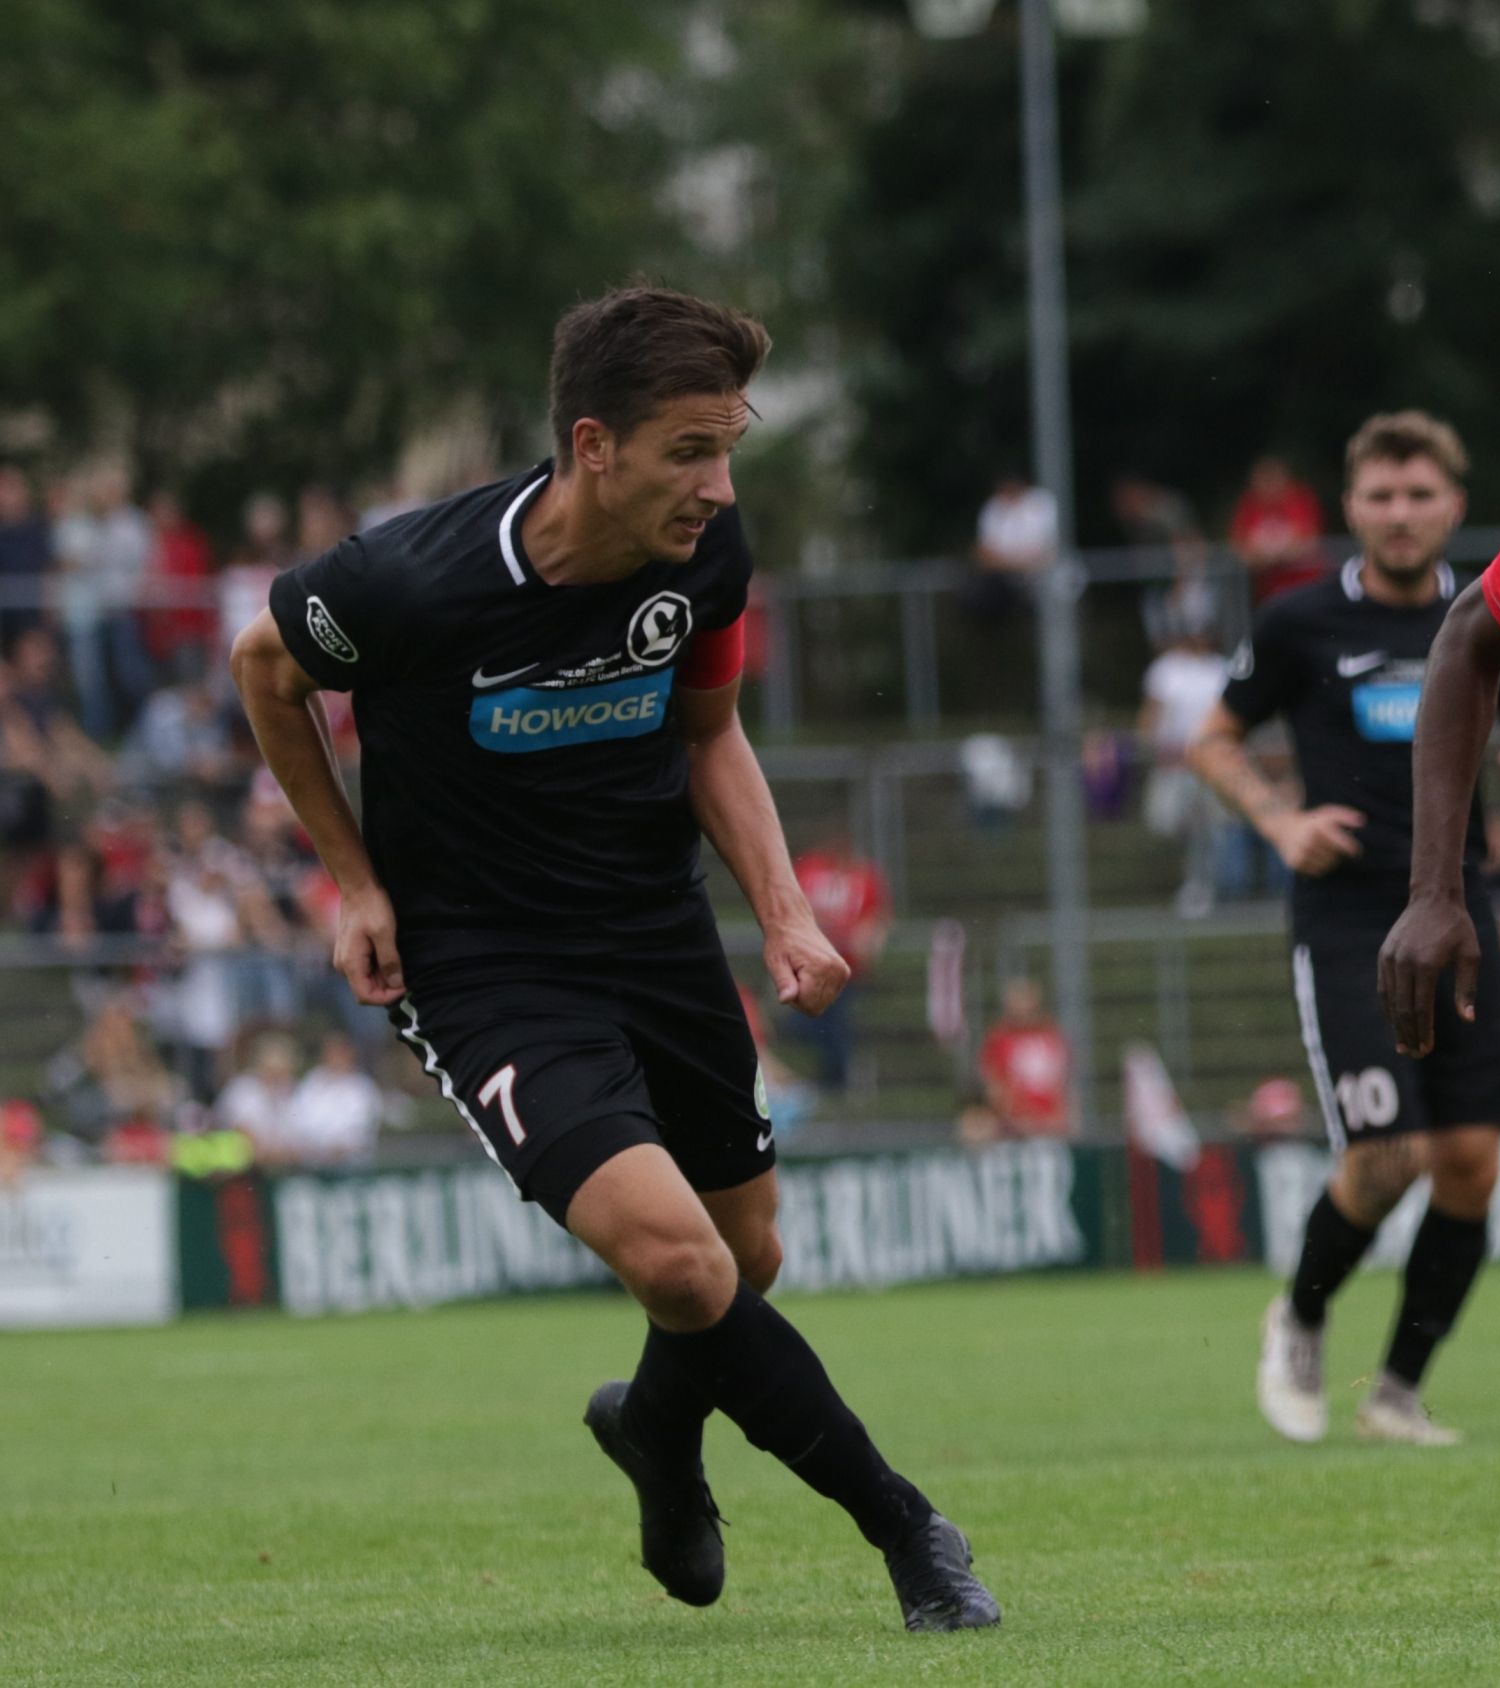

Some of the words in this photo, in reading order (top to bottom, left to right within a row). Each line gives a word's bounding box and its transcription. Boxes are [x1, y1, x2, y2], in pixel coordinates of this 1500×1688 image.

[490, 691, 659, 735] HOWOGE
[477, 1063, 527, 1147] 7
[1336, 1067, 1399, 1131] 10
[777, 1139, 1083, 1292] ERLINER
